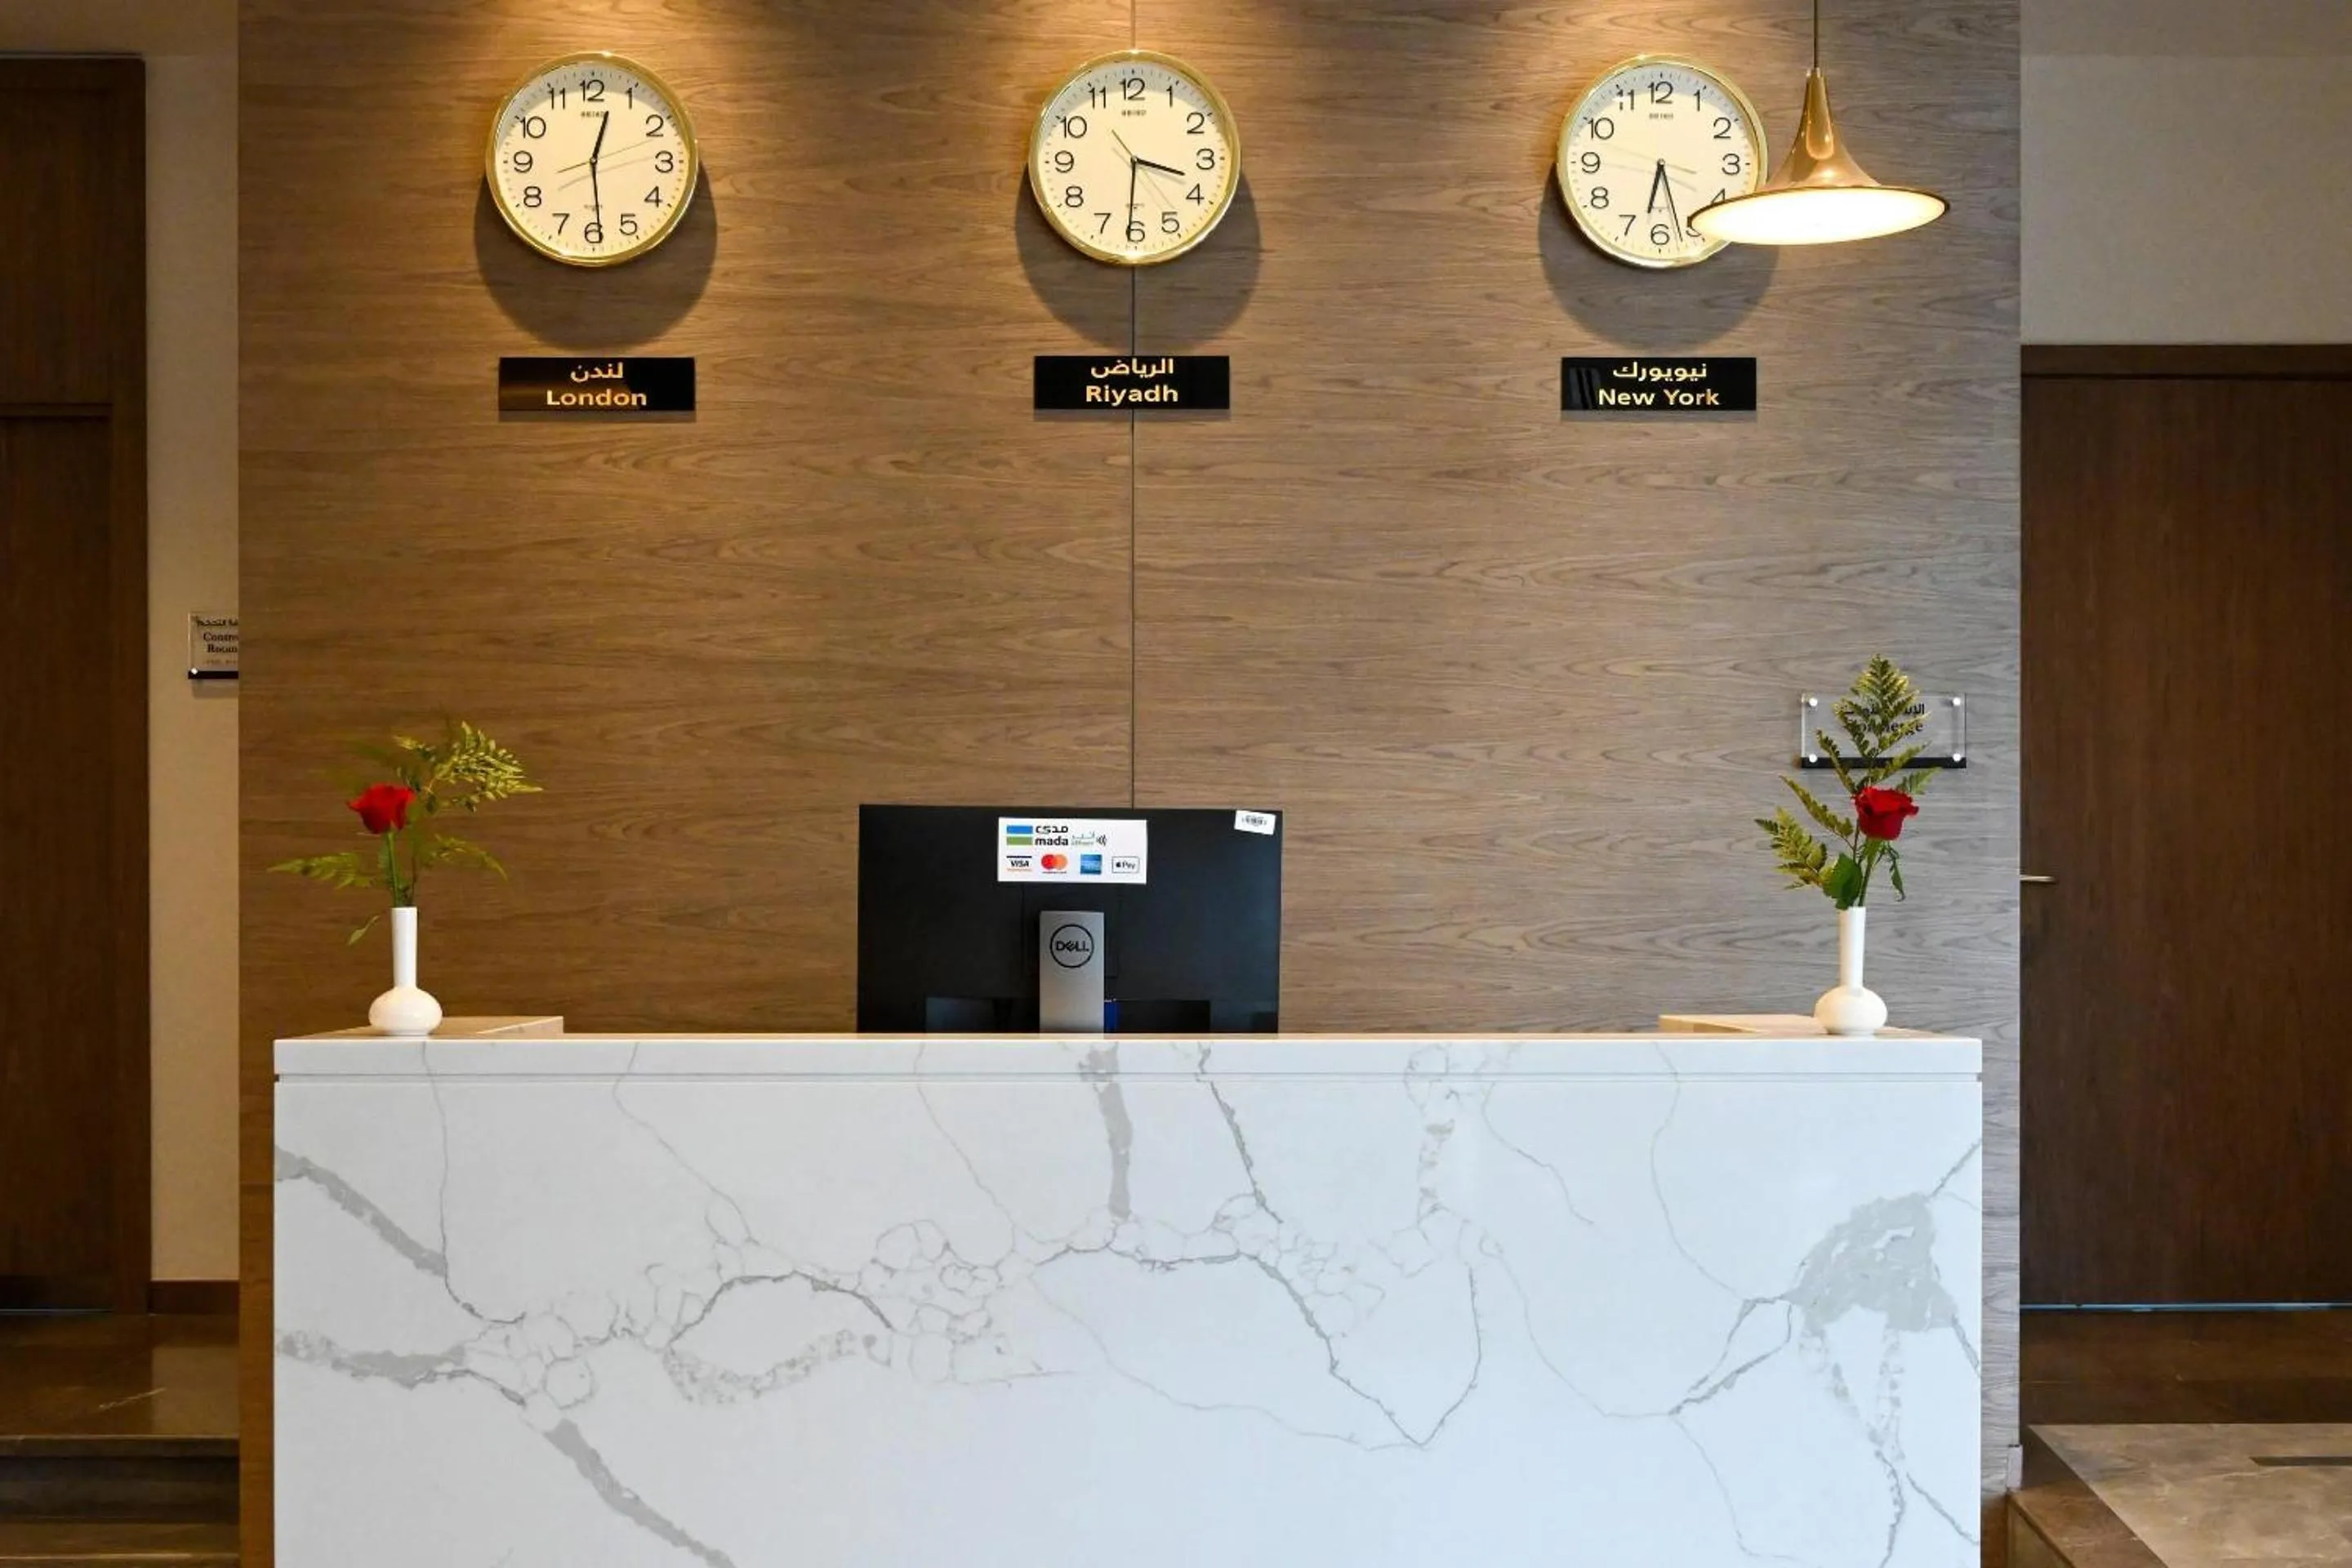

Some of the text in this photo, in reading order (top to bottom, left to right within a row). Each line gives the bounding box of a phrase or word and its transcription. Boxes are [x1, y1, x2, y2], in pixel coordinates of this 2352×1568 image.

[548, 87, 566, 110] 11
[579, 79, 605, 102] 12
[625, 87, 633, 110] 1
[1089, 87, 1107, 109] 11
[1119, 78, 1146, 101] 12
[1166, 85, 1174, 108] 1
[1616, 89, 1635, 111] 11
[1647, 81, 1673, 105] 12
[1694, 89, 1701, 112] 1
[520, 116, 546, 139] 10
[645, 114, 664, 137] 2
[1060, 115, 1088, 139] 10
[1187, 112, 1205, 135] 2
[1588, 117, 1615, 140] 10
[1713, 117, 1731, 139] 2
[513, 150, 533, 173] 9
[654, 150, 674, 173] 3
[1054, 150, 1075, 173] 9
[1196, 148, 1215, 171] 3
[1581, 151, 1601, 174] 9
[1722, 153, 1740, 176] 3
[523, 186, 542, 207] 8
[644, 185, 663, 208] 4
[1064, 185, 1085, 208] 8
[1185, 183, 1205, 206] 4
[1590, 186, 1610, 209] 8
[552, 213, 570, 235] 7
[584, 222, 604, 244] 6
[619, 213, 638, 236] 5
[1094, 212, 1111, 234] 7
[1126, 220, 1146, 243] 6
[1161, 211, 1180, 234] 5
[1619, 214, 1637, 236] 7
[1650, 224, 1670, 246] 6
[570, 362, 624, 383] لندن
[1090, 358, 1174, 379] الرياض
[1613, 362, 1708, 382] نيويورك
[546, 389, 647, 406] London
[1085, 385, 1178, 407] Riyadh
[1598, 388, 1720, 406] New York
[1035, 836, 1068, 846] mada
[1122, 862, 1135, 870] Pay
[1055, 940, 1089, 952] DELL
